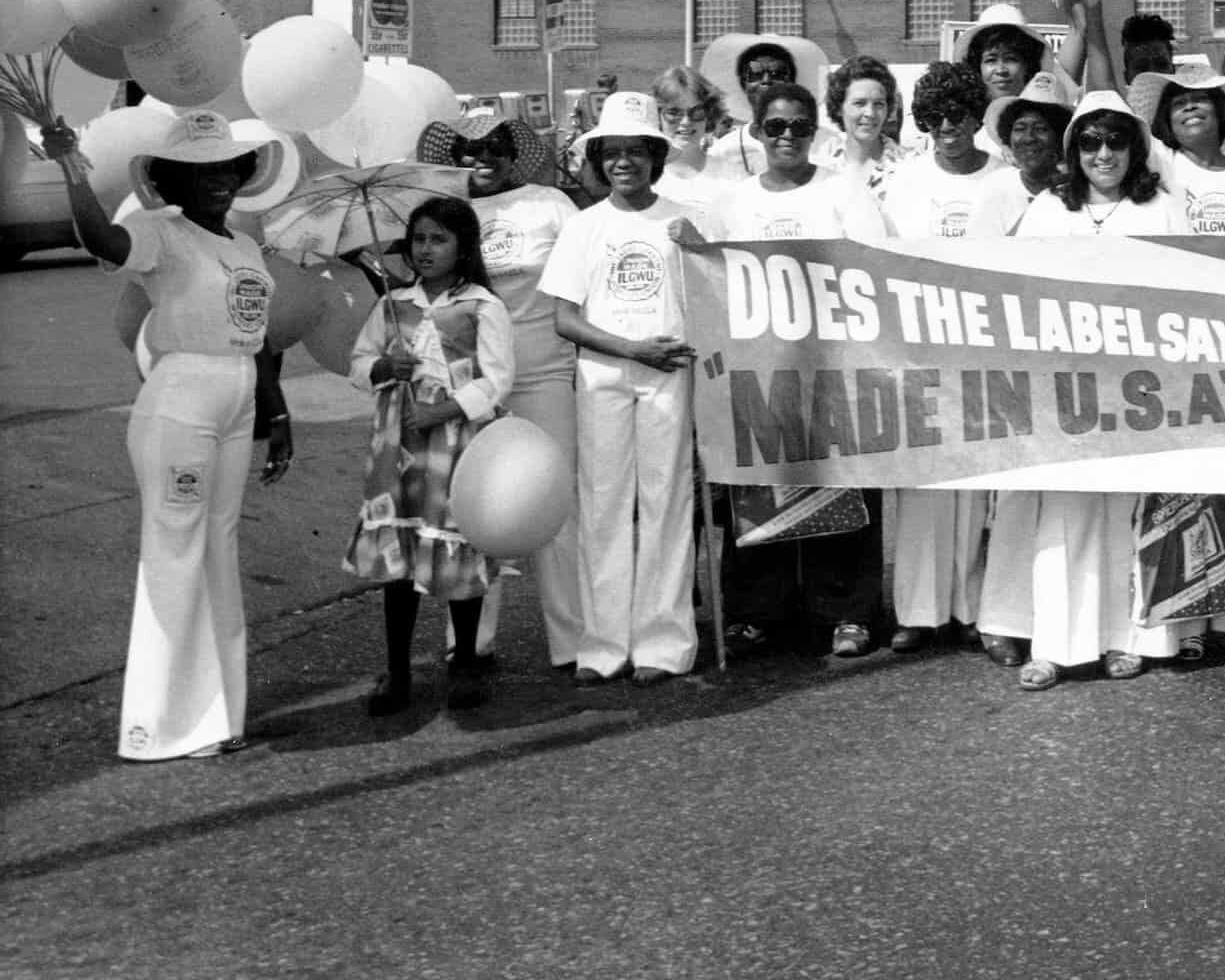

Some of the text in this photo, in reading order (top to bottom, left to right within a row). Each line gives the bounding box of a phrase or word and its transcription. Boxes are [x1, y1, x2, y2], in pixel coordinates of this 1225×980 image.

[724, 248, 881, 342] DOES
[886, 277, 995, 347] THE
[1002, 293, 1155, 357] LABEL
[961, 369, 1033, 443] IN
